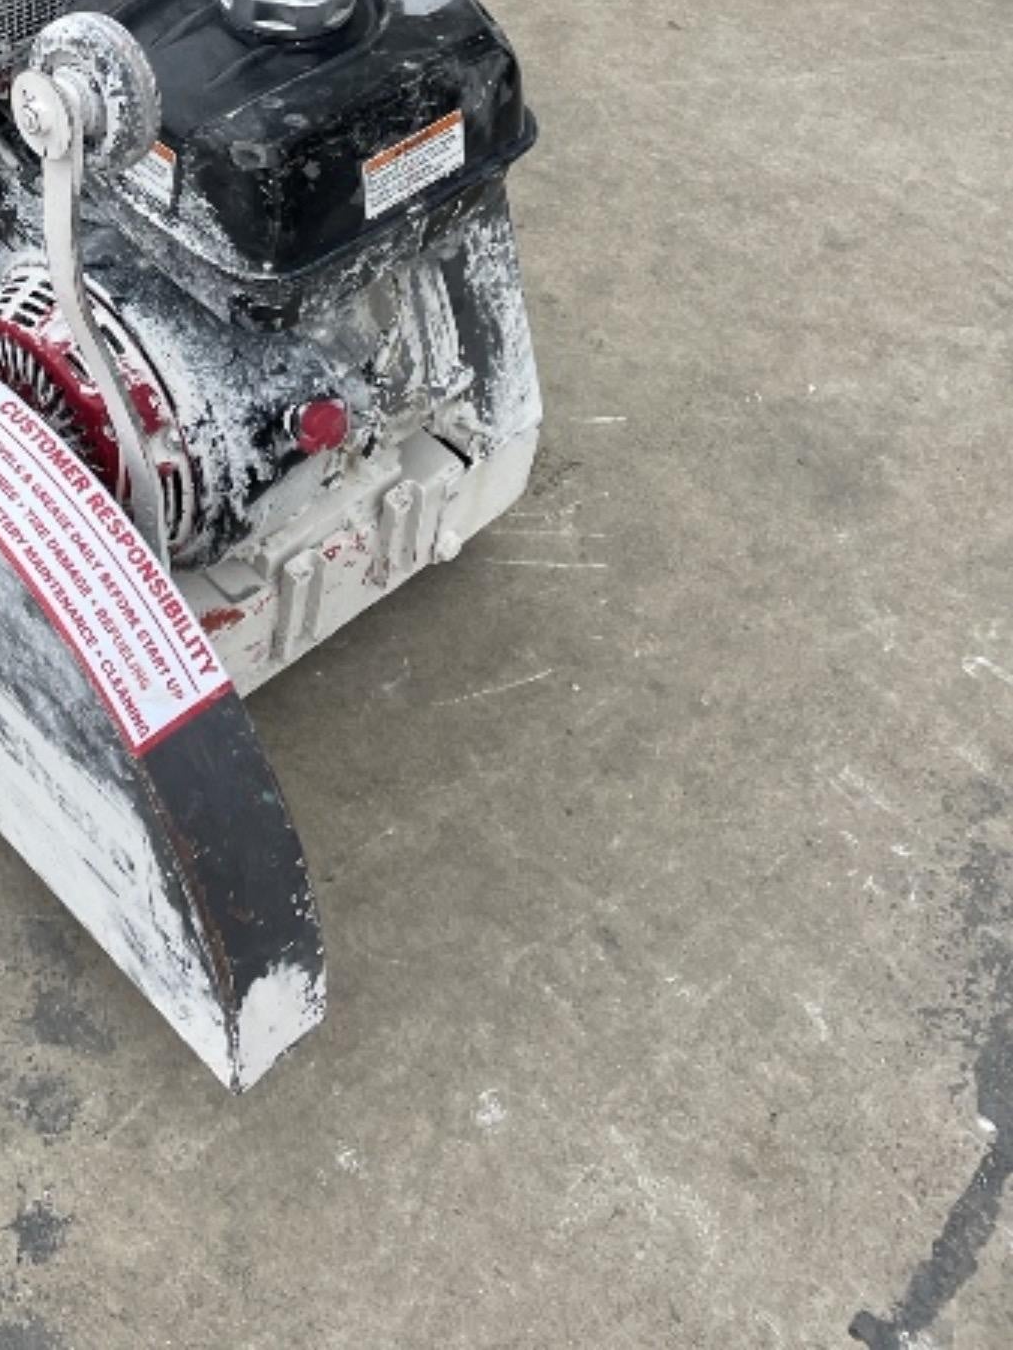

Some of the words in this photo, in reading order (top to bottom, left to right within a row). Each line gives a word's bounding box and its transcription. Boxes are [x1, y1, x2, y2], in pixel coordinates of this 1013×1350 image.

[0, 401, 92, 494] CUSTOMER
[86, 489, 218, 675] RESPONSIBILITY
[26, 508, 50, 540] TIRE
[46, 538, 92, 597] DAMAGE
[95, 608, 149, 690] REFUELING
[32, 483, 74, 531] GREASE
[70, 532, 104, 570] DAILY
[98, 572, 141, 630] BEFORE
[137, 629, 171, 675] START
[23, 546, 98, 648] MAINTENANCE
[100, 659, 150, 739] CLEANING
